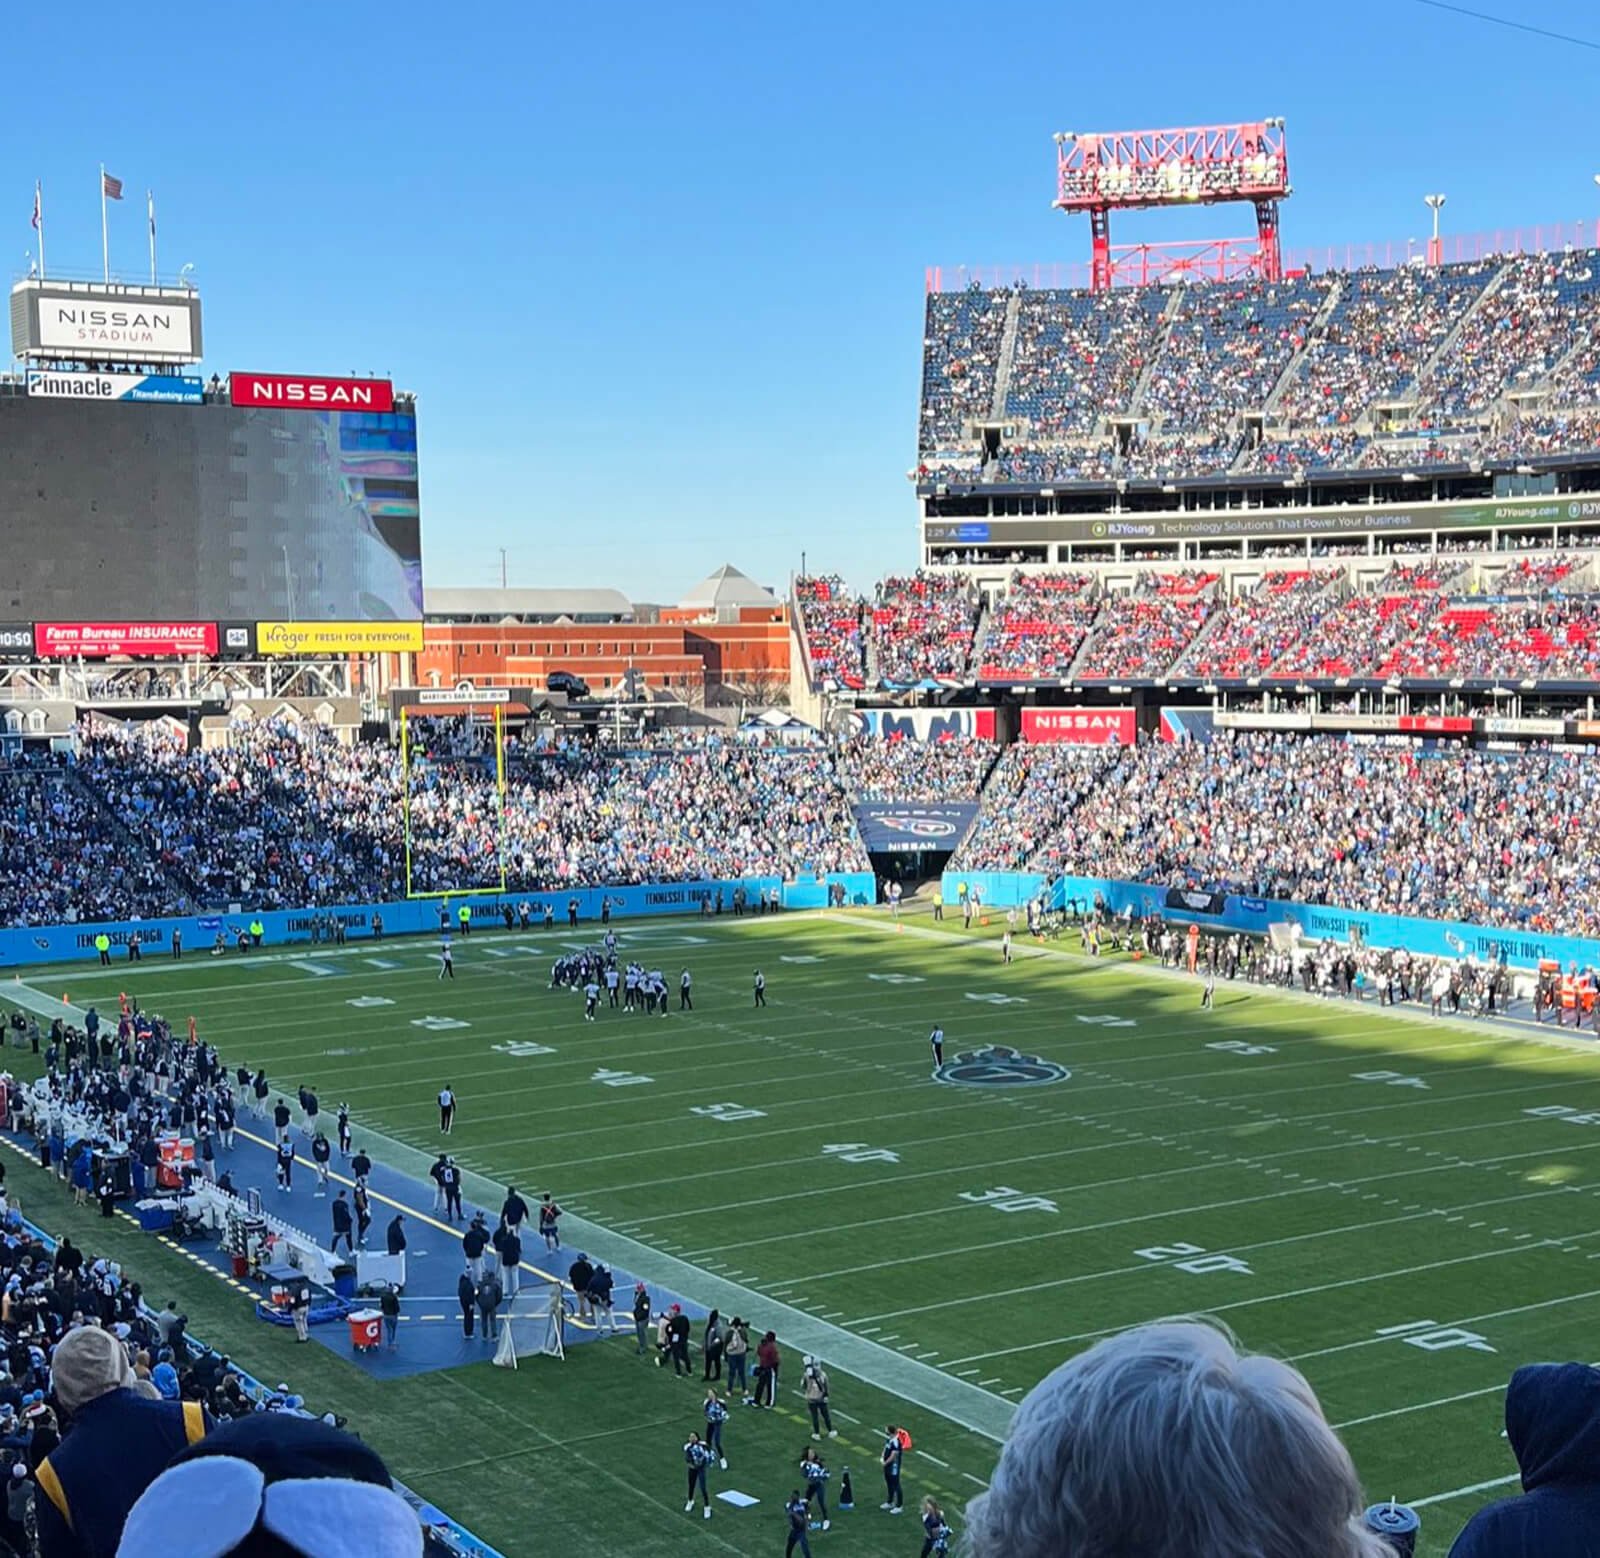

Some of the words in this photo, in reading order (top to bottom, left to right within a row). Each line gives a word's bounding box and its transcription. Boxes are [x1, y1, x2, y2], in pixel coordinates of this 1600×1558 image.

[58, 309, 171, 329] NISSAN
[78, 328, 154, 343] STADIUM
[30, 373, 112, 396] Pinnacle
[252, 382, 372, 404] NISSAN
[132, 389, 200, 402] TitansBanking.com
[1495, 506, 1559, 518] RJYoung.com
[1582, 503, 1600, 516] RJY
[1108, 522, 1155, 536] RJYoung
[1161, 522, 1222, 534] Technology
[1224, 520, 1274, 531] Solutions
[1277, 518, 1300, 529] That
[1303, 517, 1336, 528] Power
[1338, 516, 1362, 526] Your
[1364, 513, 1412, 526] Business
[46, 626, 79, 640] Farm
[82, 626, 126, 640] Bureau
[128, 626, 206, 639] INSURANCE
[266, 624, 309, 650] Kroger
[315, 632, 343, 642] FRESH
[345, 632, 363, 642] FOR
[1035, 714, 1121, 729] NISSAN
[888, 841, 937, 851] NISSAN
[1204, 1040, 1280, 1057] 50
[690, 1102, 769, 1121] 50
[821, 1143, 900, 1163] 40
[957, 1186, 1058, 1213] 30
[1133, 1242, 1249, 1275] 20
[366, 1321, 378, 1338] G
[1375, 1319, 1487, 1351] 10
